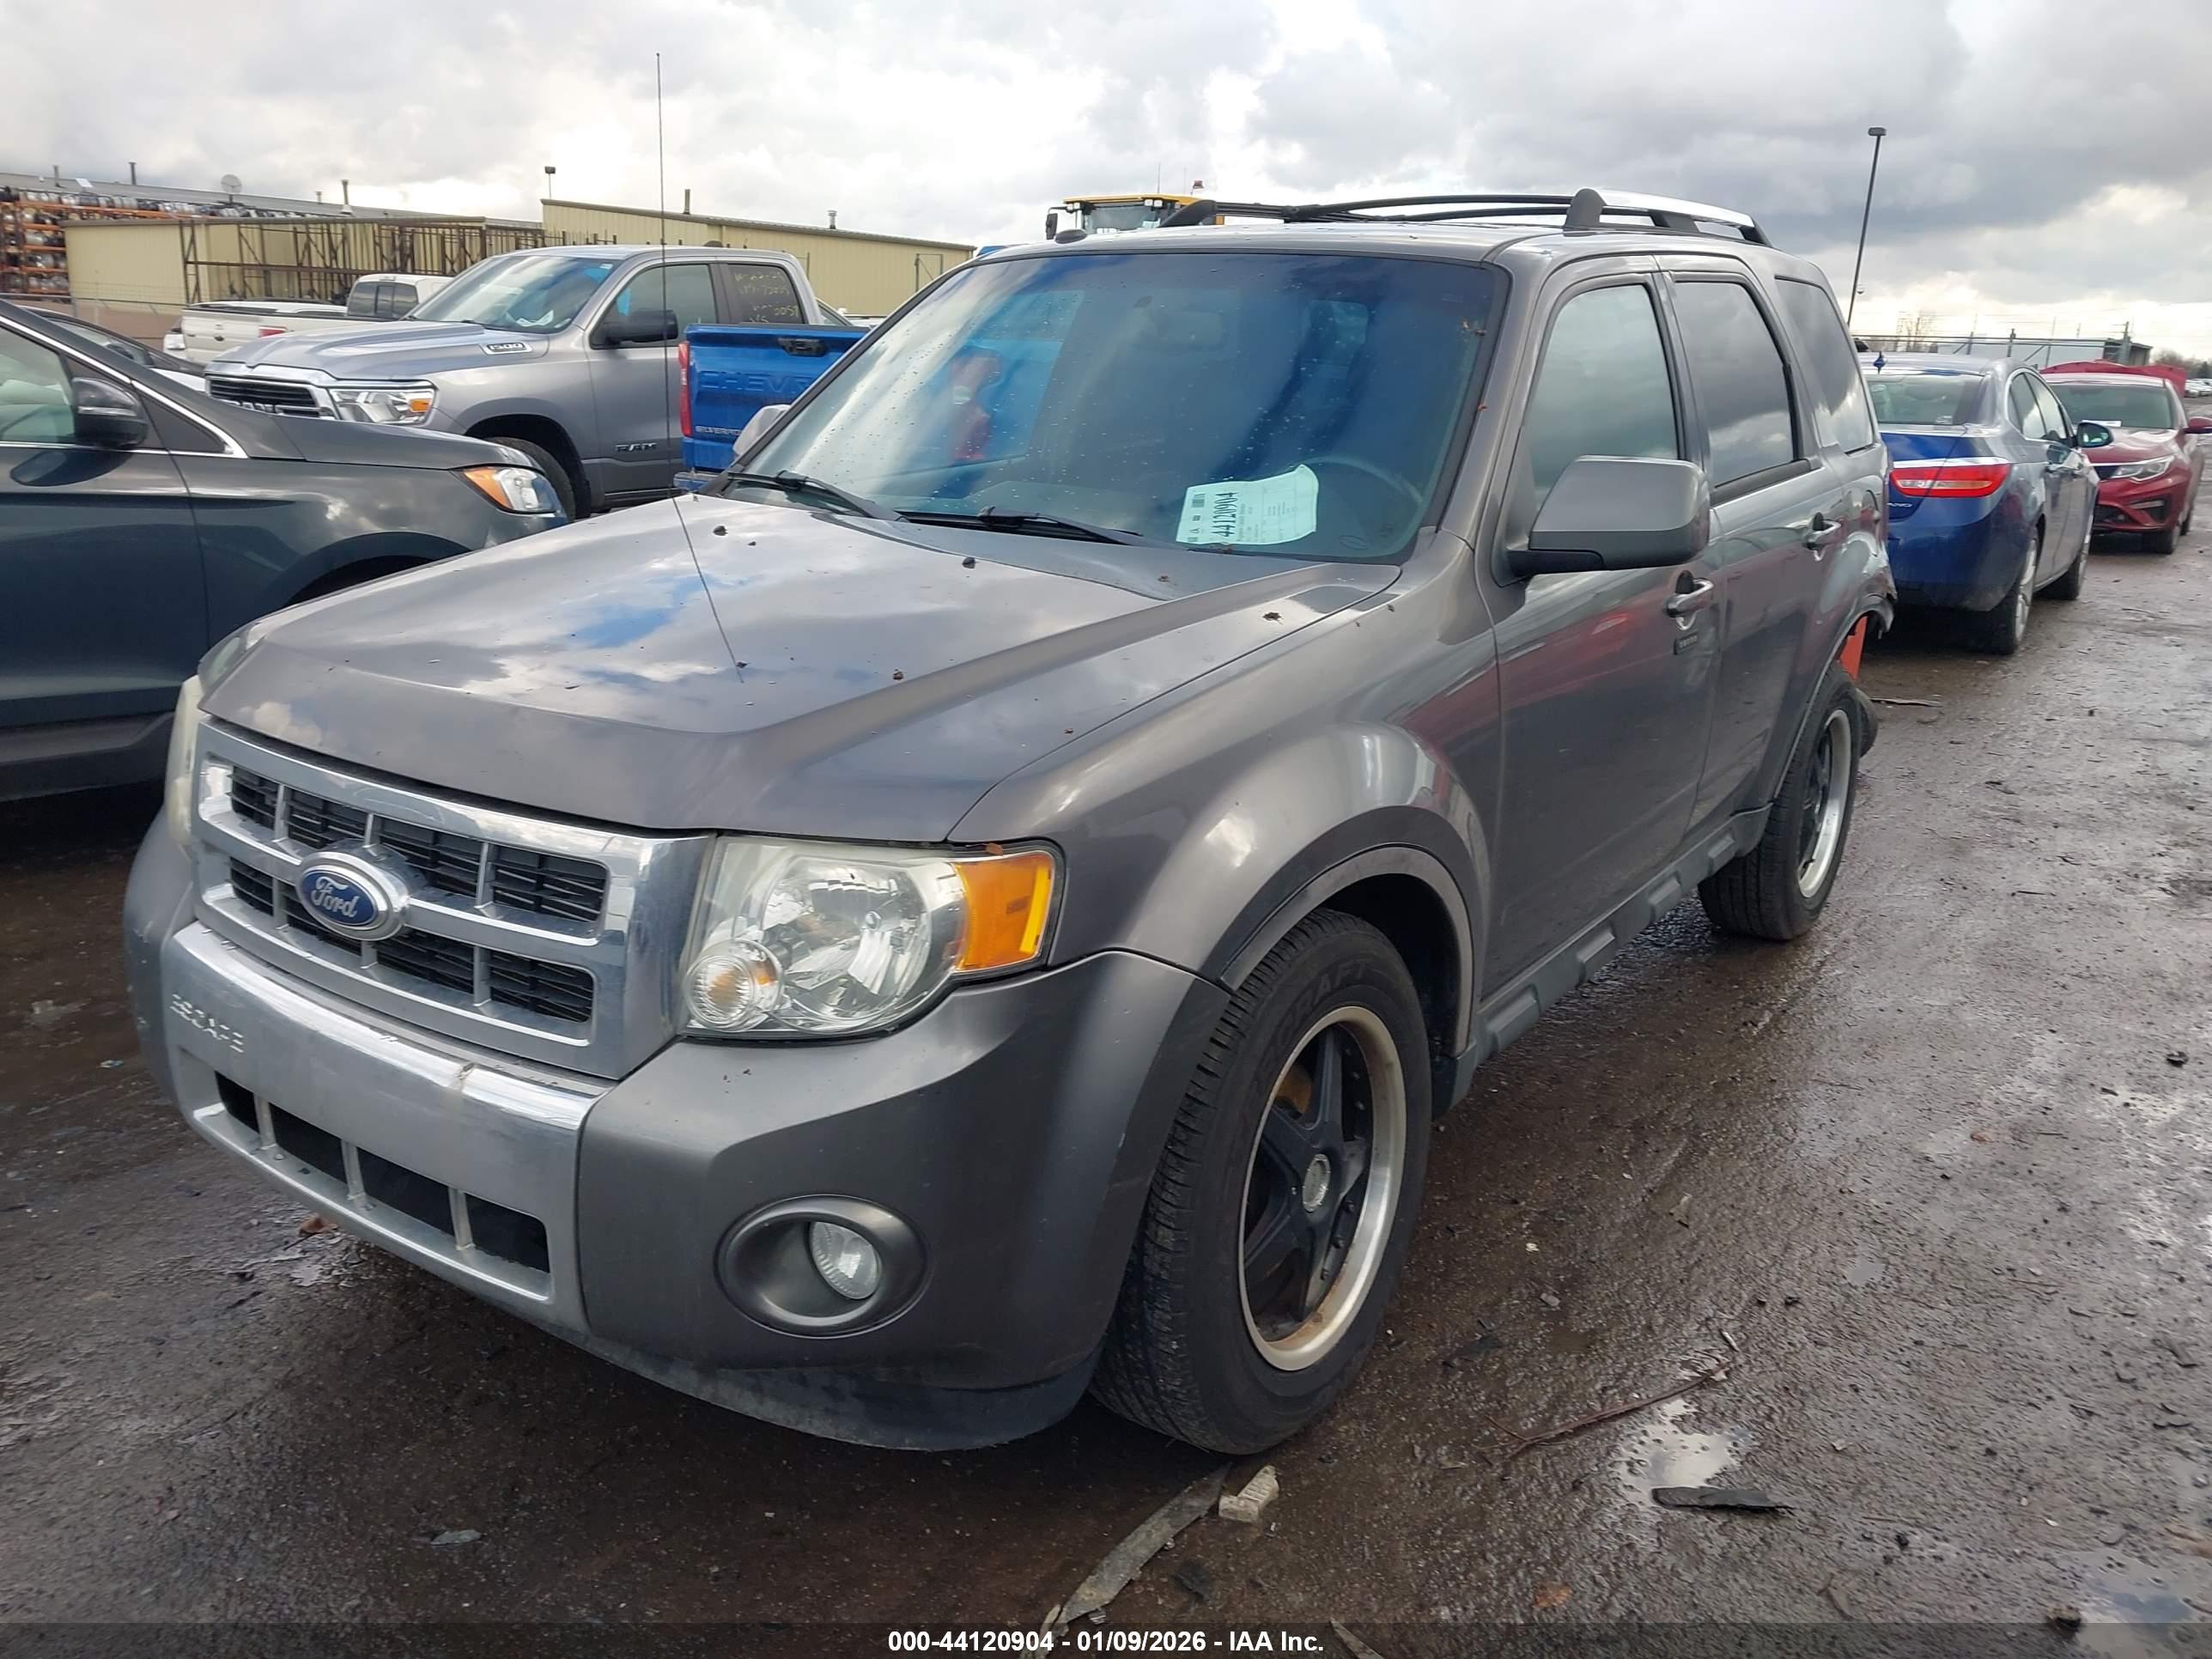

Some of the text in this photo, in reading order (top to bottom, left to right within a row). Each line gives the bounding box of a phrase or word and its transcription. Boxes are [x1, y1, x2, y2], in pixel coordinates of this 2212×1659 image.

[615, 443, 657, 452] RAM
[1209, 492, 1239, 538] 44120904
[310, 875, 360, 918] Ford
